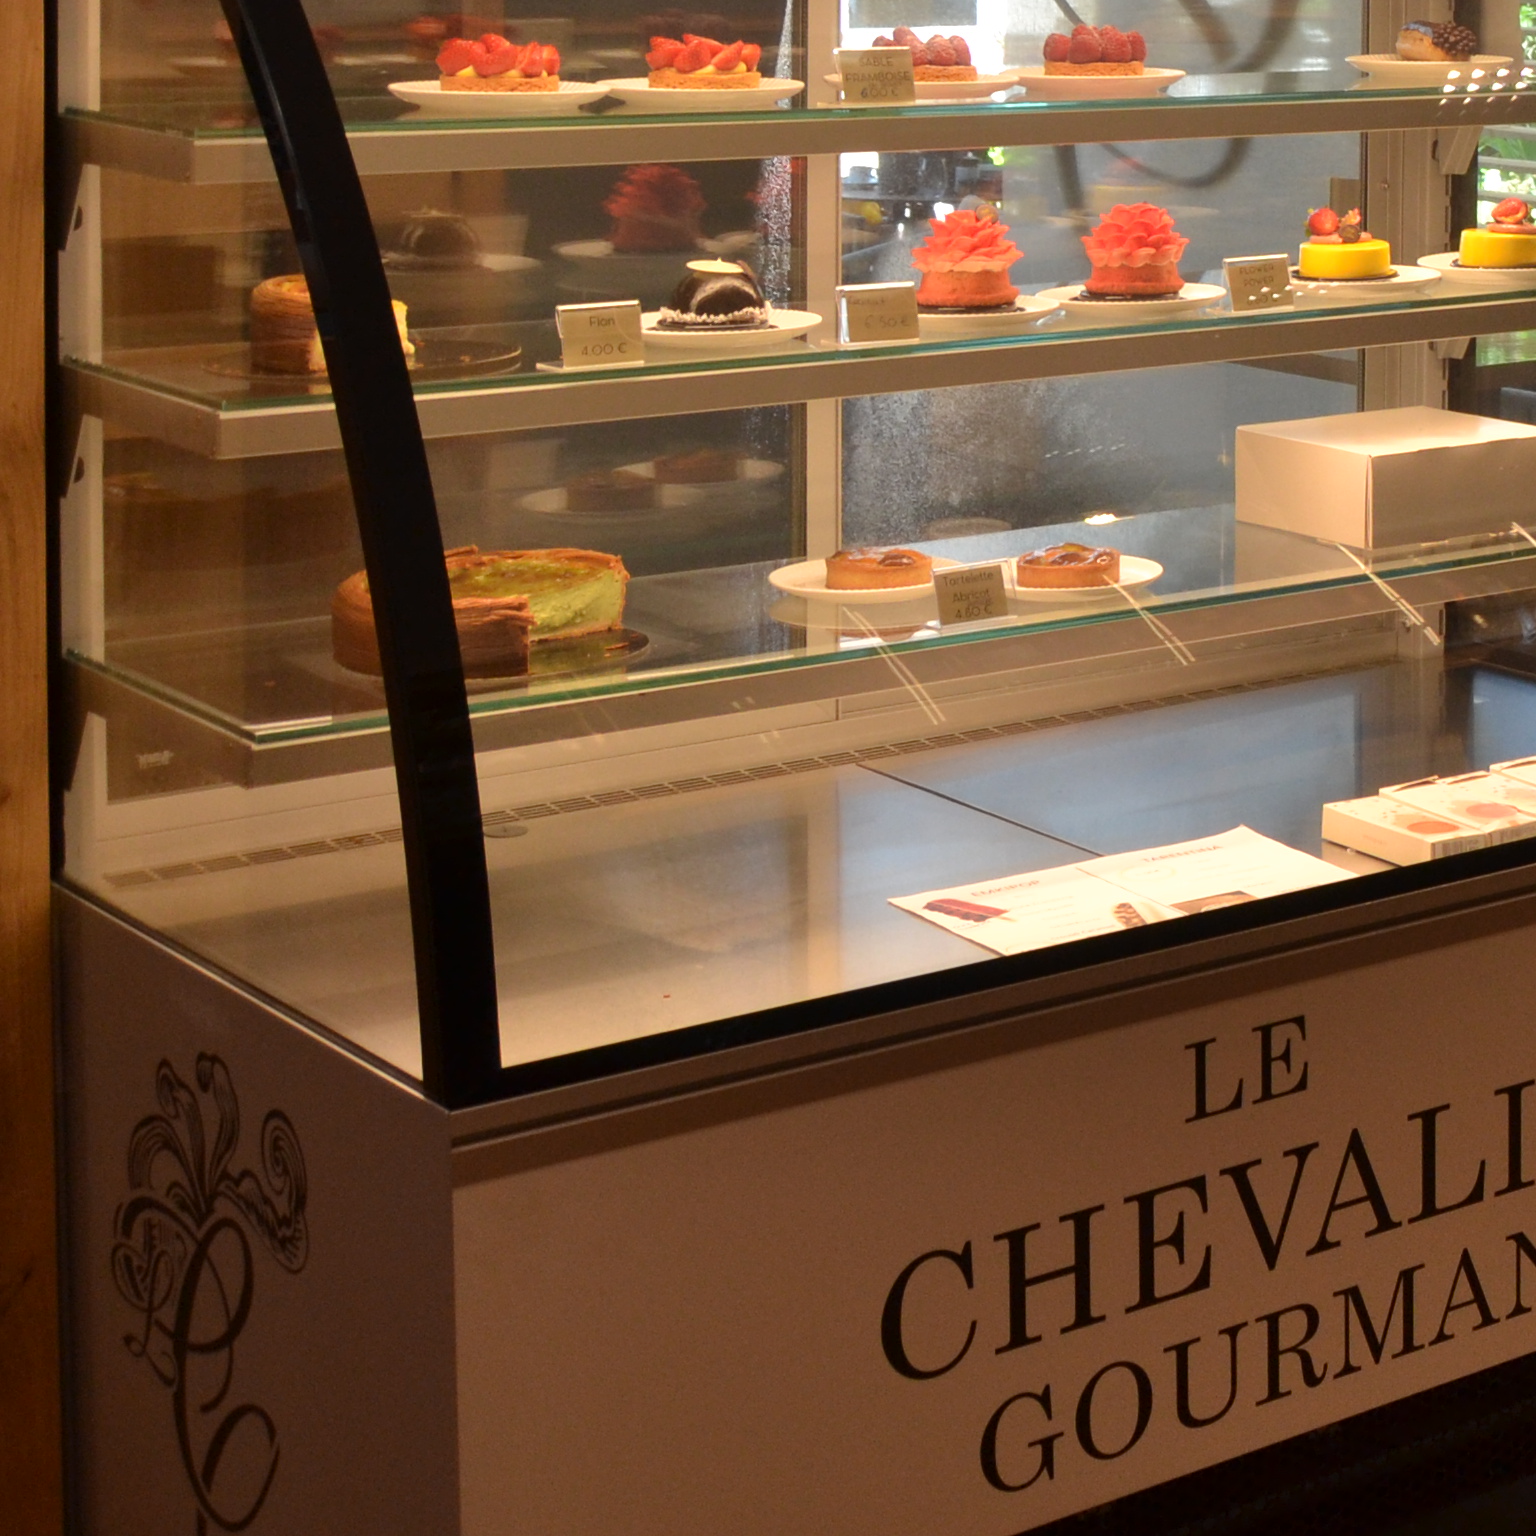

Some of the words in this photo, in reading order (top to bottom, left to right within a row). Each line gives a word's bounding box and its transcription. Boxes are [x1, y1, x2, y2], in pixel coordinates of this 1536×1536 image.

[845, 70, 911, 83] FRAMBOISE
[589, 315, 616, 327] Flan
[942, 571, 994, 587] Tartelette
[952, 588, 991, 603] Abricot
[1183, 1015, 1309, 1125] LE
